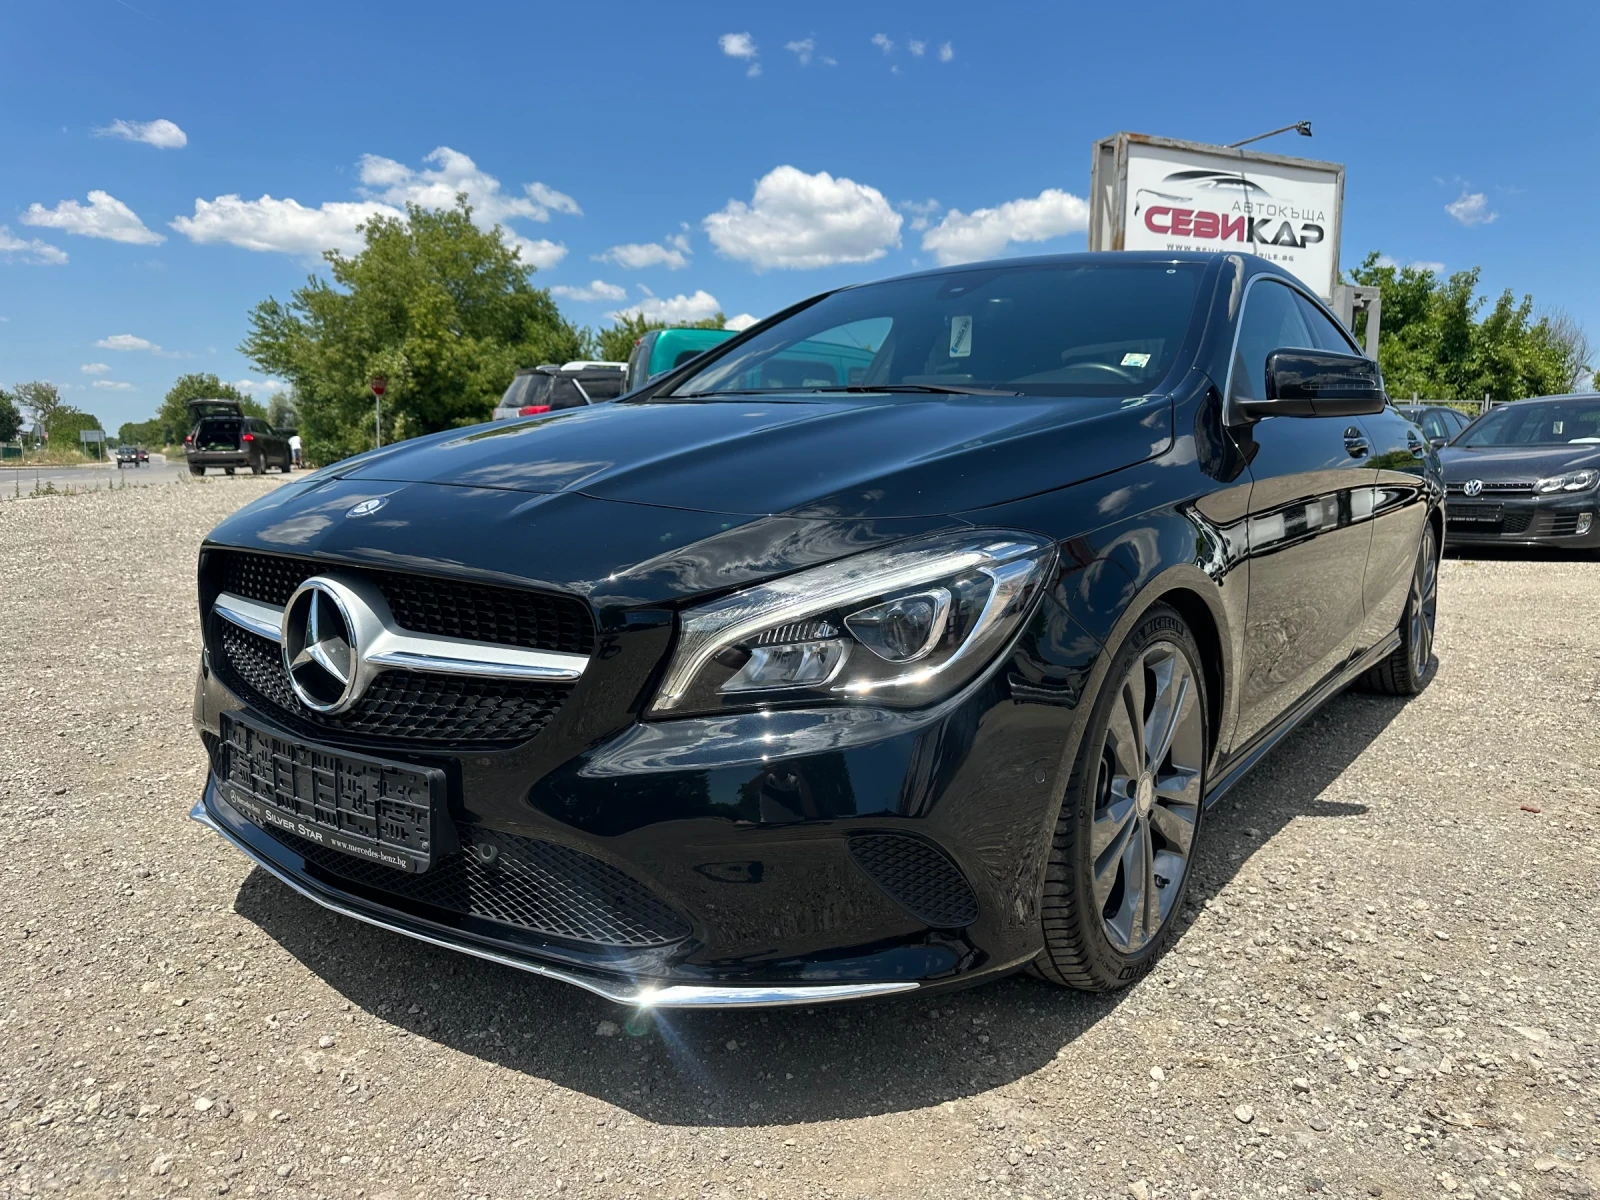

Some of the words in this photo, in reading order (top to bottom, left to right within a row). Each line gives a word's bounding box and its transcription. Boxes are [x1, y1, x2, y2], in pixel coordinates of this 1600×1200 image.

[1231, 200, 1326, 223] АВТОКЪЩА
[1144, 617, 1184, 637] MICHELIN
[265, 809, 296, 831] SILVER
[297, 823, 324, 843] STAR
[330, 838, 407, 868] www.mercedes-benz.bg
